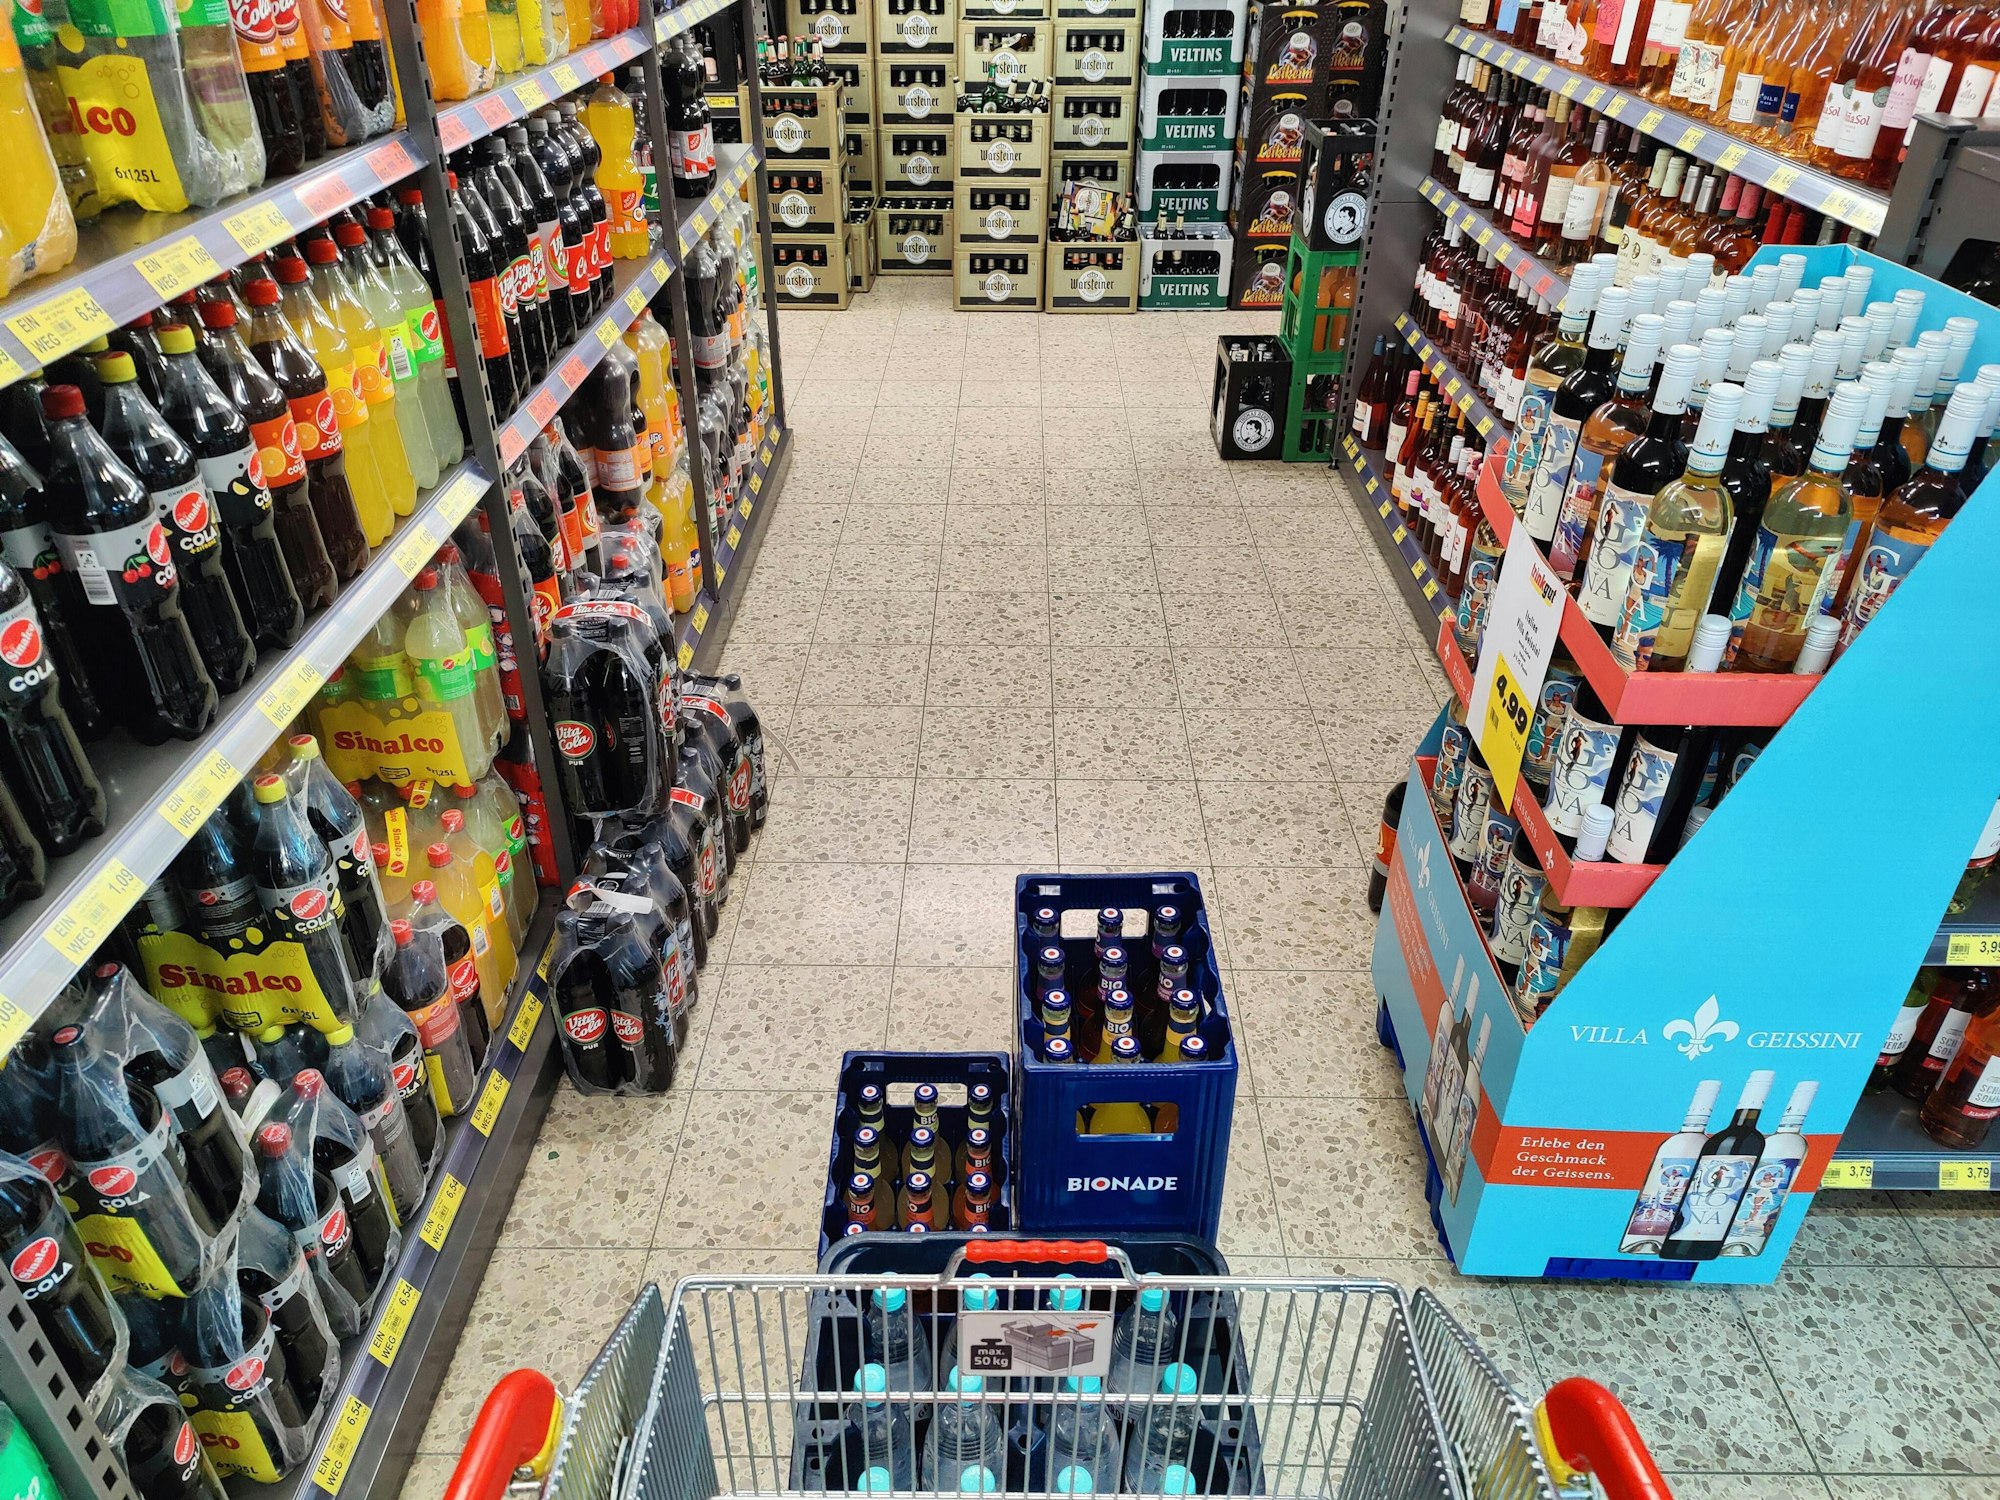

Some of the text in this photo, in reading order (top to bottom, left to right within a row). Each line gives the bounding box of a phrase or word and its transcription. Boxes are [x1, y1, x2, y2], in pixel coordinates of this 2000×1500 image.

[808, 22, 850, 37] Warsteiner
[896, 22, 938, 37] Warsteiner
[259, 46, 276, 56] MIX
[1170, 48, 1222, 63] VELTINS
[982, 61, 1027, 74] Wrsteiner
[1075, 59, 1114, 71] Warsteiner
[1266, 64, 1313, 82] Leikeim
[898, 95, 939, 108] Warsteiner
[765, 127, 811, 141] Warsteiner
[1072, 125, 1111, 136] Warsteiner
[1165, 125, 1215, 139] VELTINS
[980, 150, 1022, 162] Warsteiner
[1256, 144, 1301, 159] Leikeim
[115, 167, 160, 183] 6x1,25 L
[900, 163, 940, 175] Warsteiner
[772, 203, 817, 216] Warsteiner
[1160, 197, 1209, 211] VELTINS
[229, 219, 245, 232] EIN
[979, 217, 1020, 230] Warsteiner
[1248, 219, 1293, 234] Leikeim
[240, 233, 260, 249] WEG
[896, 242, 937, 254] Warsteiner
[188, 247, 209, 266] 1,09
[142, 257, 162, 273] EIN
[154, 274, 179, 292] WEG
[778, 274, 822, 287] Warsteiner
[978, 281, 1019, 293] Warsteiner
[1070, 278, 1114, 290] Warsteiner
[1159, 283, 1209, 296] VELTINS
[1241, 289, 1283, 303] Leikeim
[75, 301, 104, 322] 6,54
[525, 303, 536, 312] PUR
[19, 315, 40, 334] EIN
[30, 332, 61, 353] WEG
[180, 527, 217, 551] COLA
[404, 559, 417, 573] WEG
[1531, 563, 1557, 603] trinkgut
[5, 622, 36, 662] Sinalco
[9, 659, 54, 693] COLA
[298, 664, 316, 684] 1,09
[263, 691, 277, 708] EIN
[272, 703, 292, 722] WEG
[556, 725, 584, 740] Vita
[334, 731, 444, 755] Sinalco
[558, 734, 591, 751] Cola
[209, 757, 231, 781] 1,09
[166, 793, 186, 813] EIN
[177, 804, 202, 829] WEG
[1514, 793, 1539, 843] eissens.
[108, 868, 135, 894] 1,09
[294, 891, 323, 917] Sinalco
[54, 914, 77, 938] EIN
[294, 912, 335, 933] COLA
[67, 927, 95, 955] WEG
[455, 962, 473, 986] Sinalco
[539, 962, 547, 973] EIN
[159, 964, 303, 995] Sinalco
[1101, 979, 1123, 990] BIO
[529, 997, 538, 1012] 6,54
[313, 1012, 320, 1020] L
[568, 1011, 599, 1029] Vita
[611, 1011, 634, 1027] Vita
[510, 1025, 519, 1037] EIN
[571, 1017, 606, 1038] Cola
[613, 1023, 642, 1038] Cola
[1107, 1022, 1130, 1033] BIO
[518, 1031, 528, 1046] WEG
[1569, 1026, 1649, 1045] VILLA
[1746, 1031, 1863, 1049] GEISSINI
[582, 1042, 599, 1051] PUR
[399, 1081, 420, 1098] OLA
[494, 1075, 504, 1091] 6,54
[473, 1106, 483, 1121] EIN
[481, 1112, 492, 1130] WEG
[920, 1114, 938, 1125] BIO
[1520, 1136, 1605, 1151] Erlebe den
[974, 1156, 991, 1167] BIO
[1516, 1151, 1607, 1166] Geschmack
[1512, 1167, 1616, 1181] der Geissens.
[1849, 1165, 1872, 1179] 3,79
[1967, 1167, 1990, 1179] 3,79
[97, 1169, 130, 1192] Sinalco
[1067, 1176, 1179, 1192] BIONADE
[446, 1178, 459, 1200] 6,54
[99, 1191, 151, 1209] COLA
[851, 1204, 870, 1213] BIO
[323, 1211, 344, 1242] Sinalco
[422, 1218, 434, 1234] EIN
[430, 1223, 445, 1245] WEG
[325, 1227, 350, 1257] COLA
[19, 1240, 52, 1280] Sinalco
[22, 1261, 73, 1301] COLA
[398, 1284, 413, 1307] 6,54
[372, 1331, 386, 1349] EIN
[380, 1335, 397, 1360] WEG
[976, 1347, 1005, 1357] max.
[974, 1356, 1009, 1369] 50 kg
[231, 1377, 273, 1404] COLA
[346, 1402, 362, 1426] 6,54
[317, 1457, 332, 1476] EIN
[326, 1460, 344, 1487] WEG
